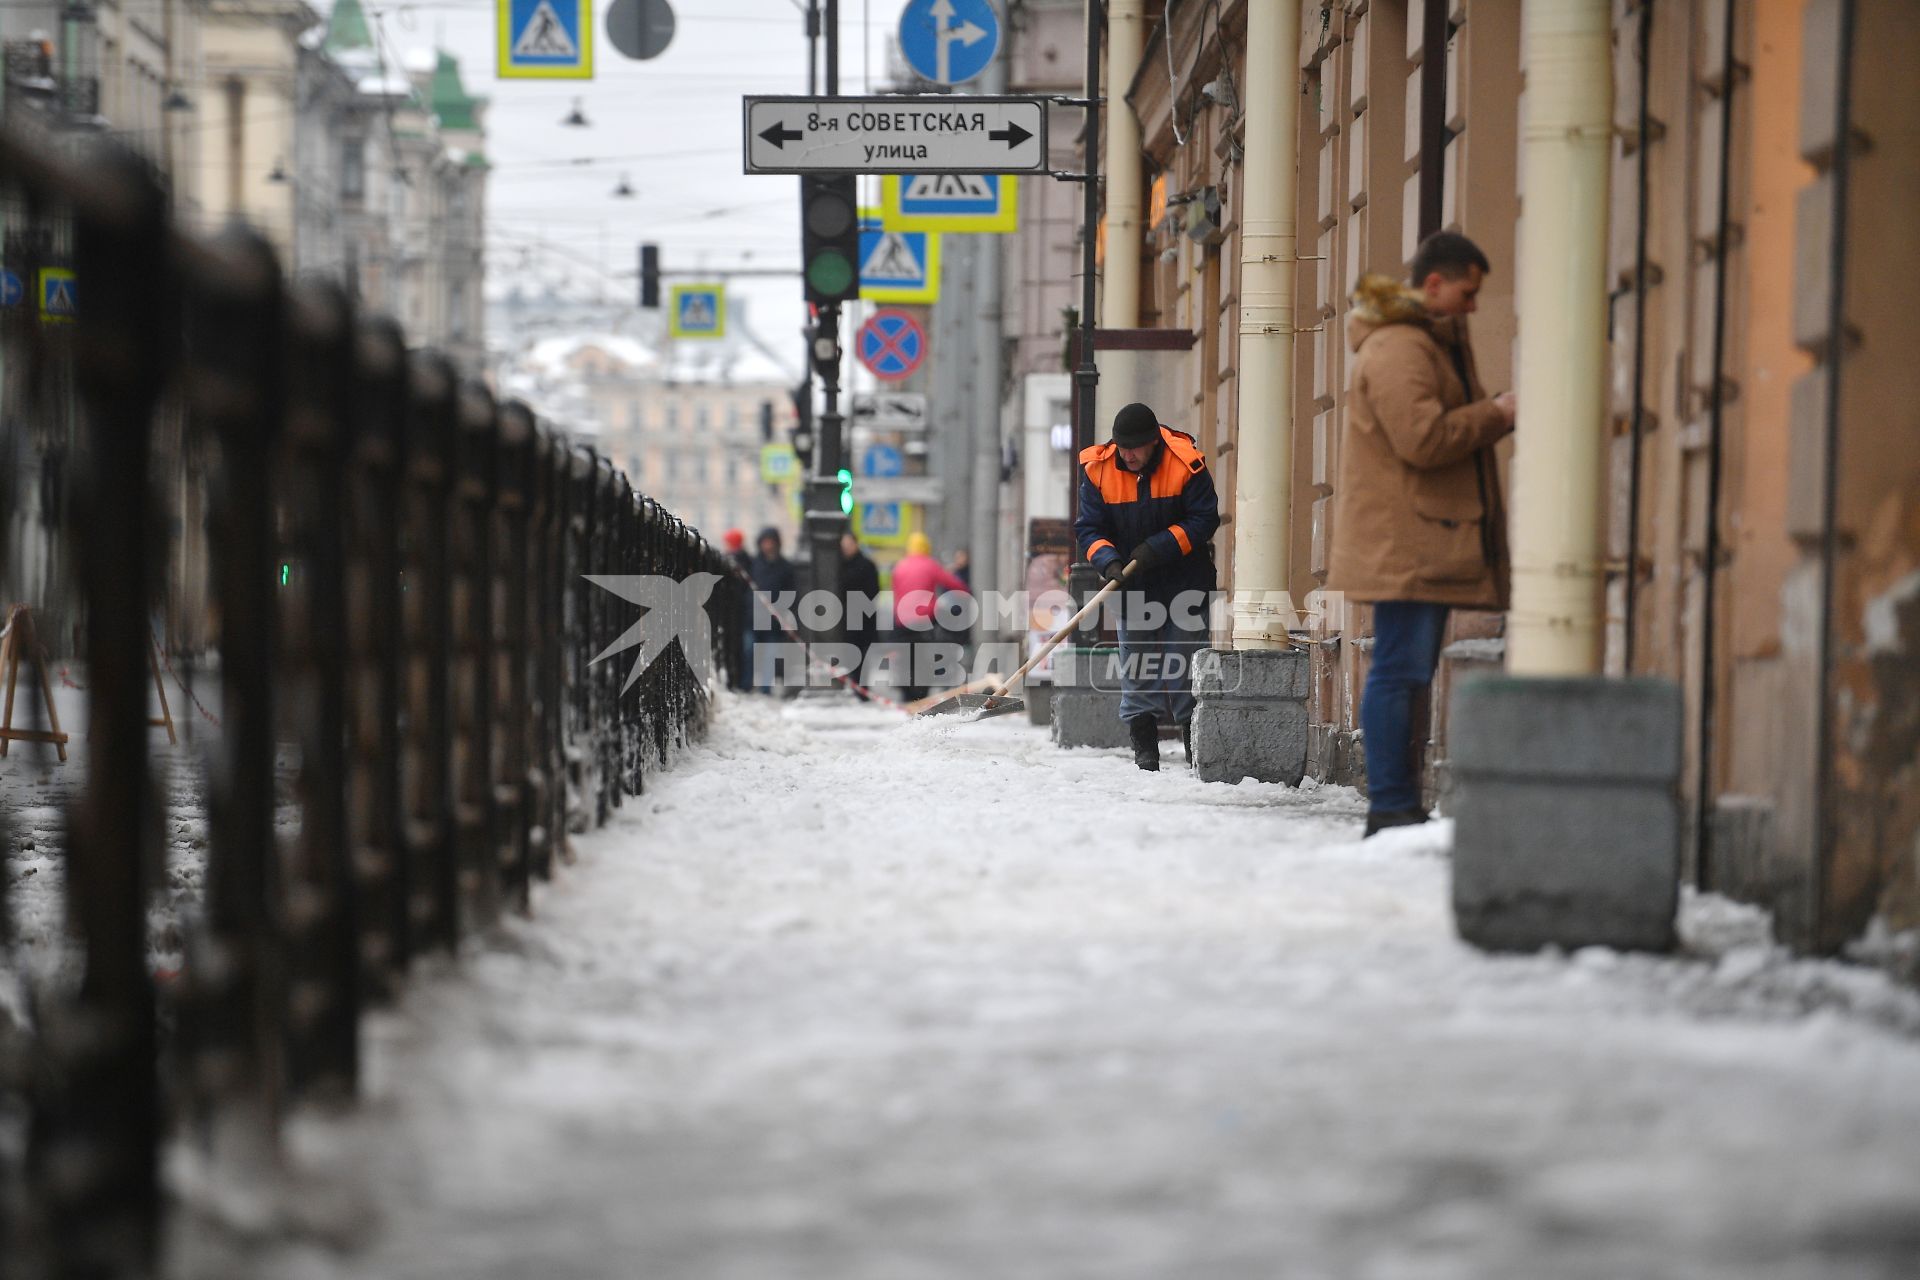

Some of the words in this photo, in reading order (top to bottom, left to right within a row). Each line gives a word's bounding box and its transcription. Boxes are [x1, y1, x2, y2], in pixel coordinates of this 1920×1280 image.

[807, 112, 839, 132] 8-я
[846, 112, 985, 132] СОВЕТСКАЯ
[863, 143, 928, 162] улица
